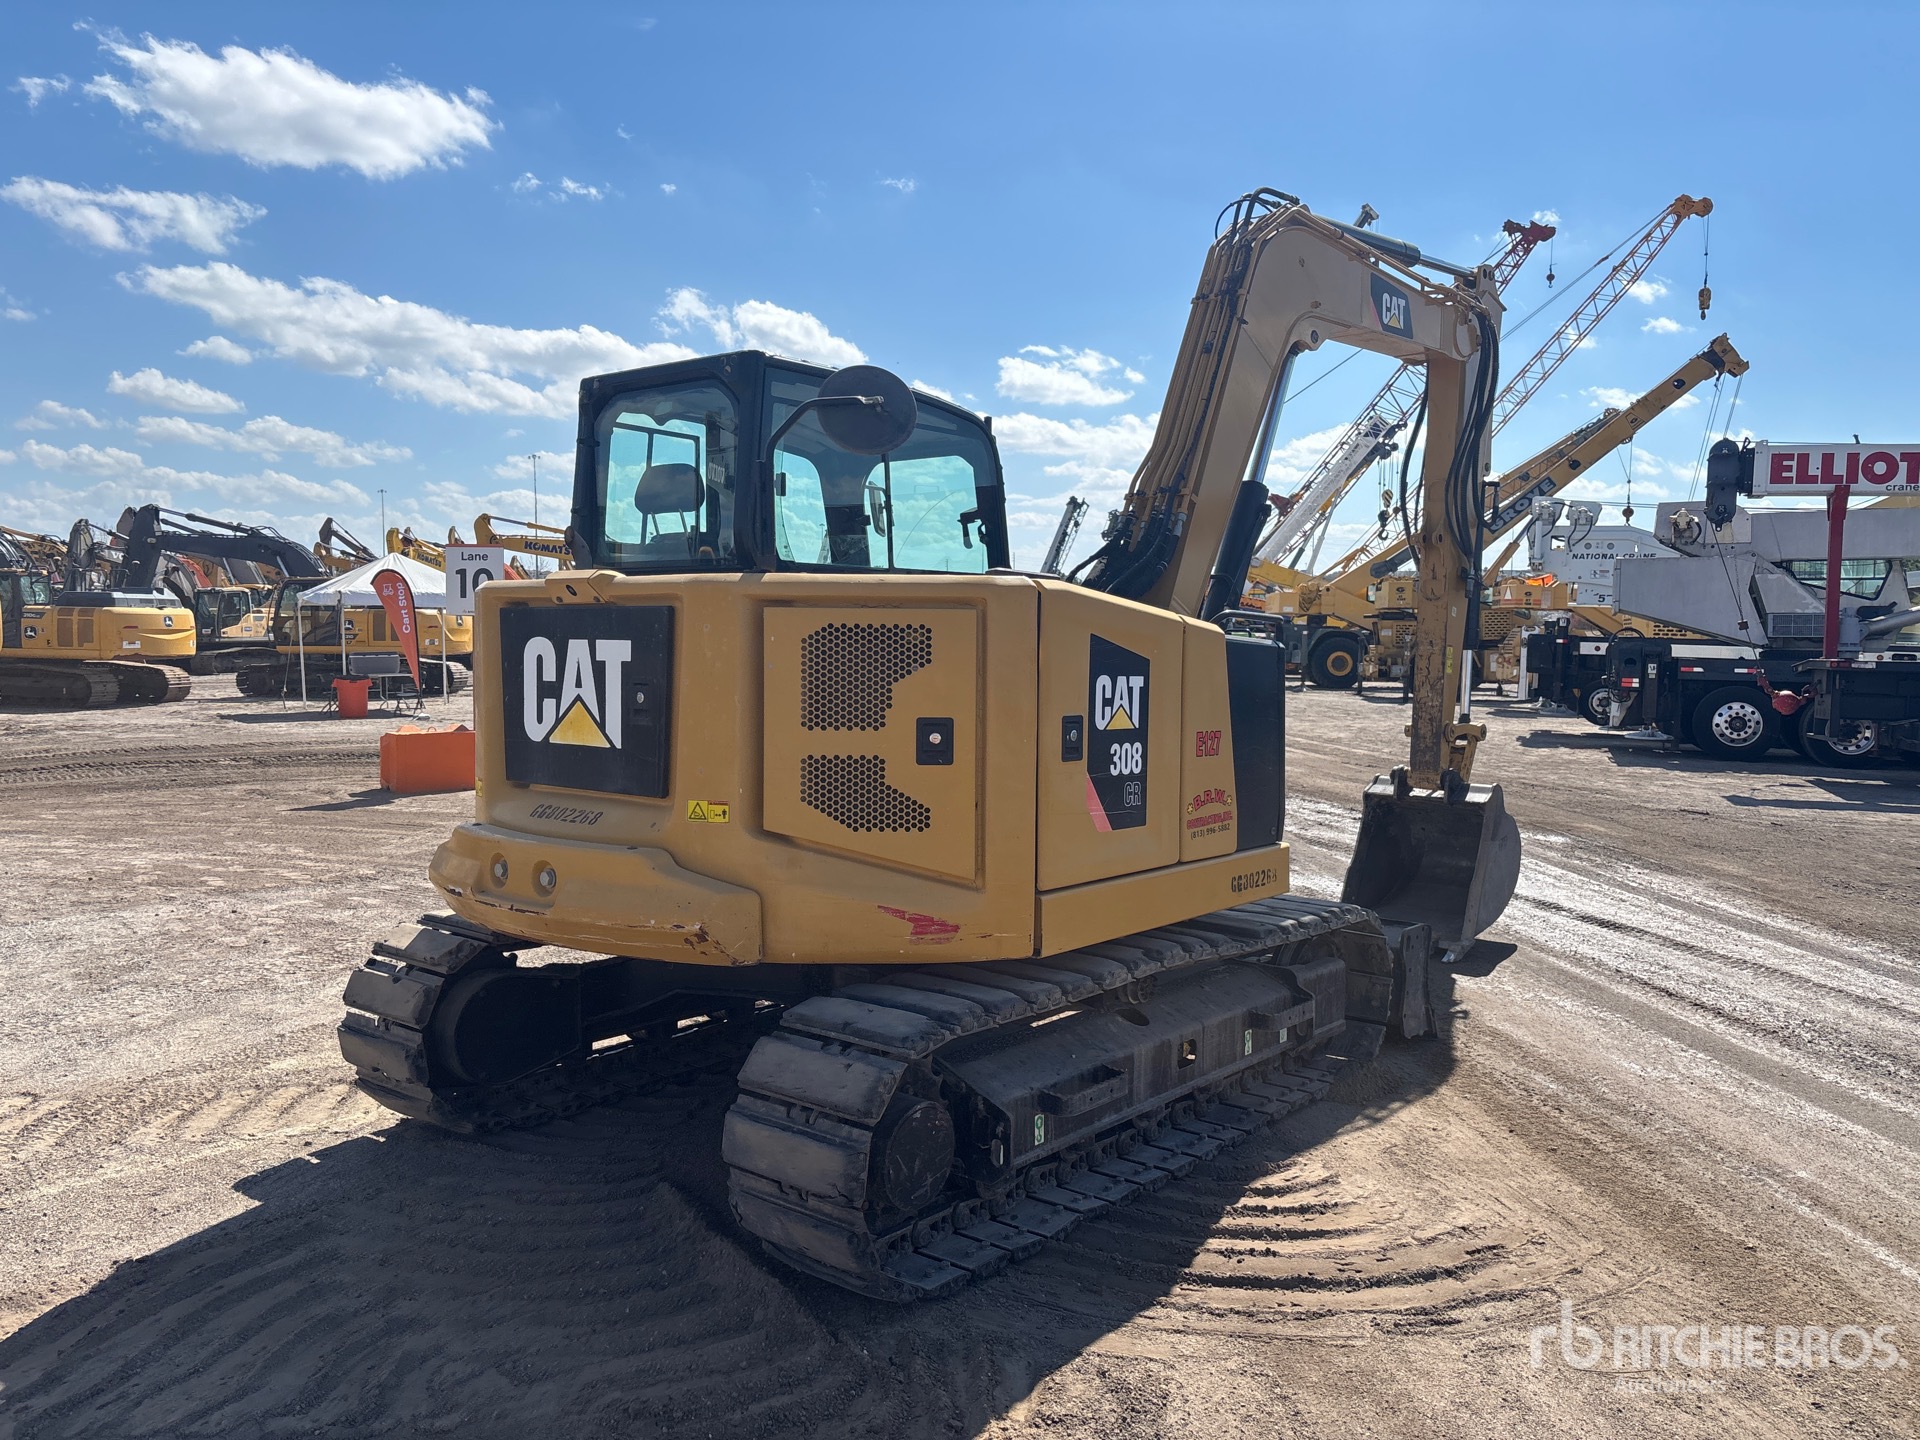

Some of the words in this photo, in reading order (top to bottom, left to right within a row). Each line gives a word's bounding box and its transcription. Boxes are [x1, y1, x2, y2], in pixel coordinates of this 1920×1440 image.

[1382, 292, 1406, 330] CAT
[1769, 451, 1920, 485] ELLIOT
[1490, 478, 1554, 531] GROVE
[417, 552, 442, 567] KOMATSU
[461, 551, 489, 562] Lane
[524, 541, 572, 555] KOMATS
[396, 582, 407, 607] Stop
[455, 568, 494, 598] 10
[402, 608, 411, 634] Cart
[523, 636, 632, 749] CAT
[1095, 674, 1144, 731] CAT
[1195, 730, 1222, 758] E127
[1110, 742, 1143, 776] 308
[1123, 782, 1141, 807] CR
